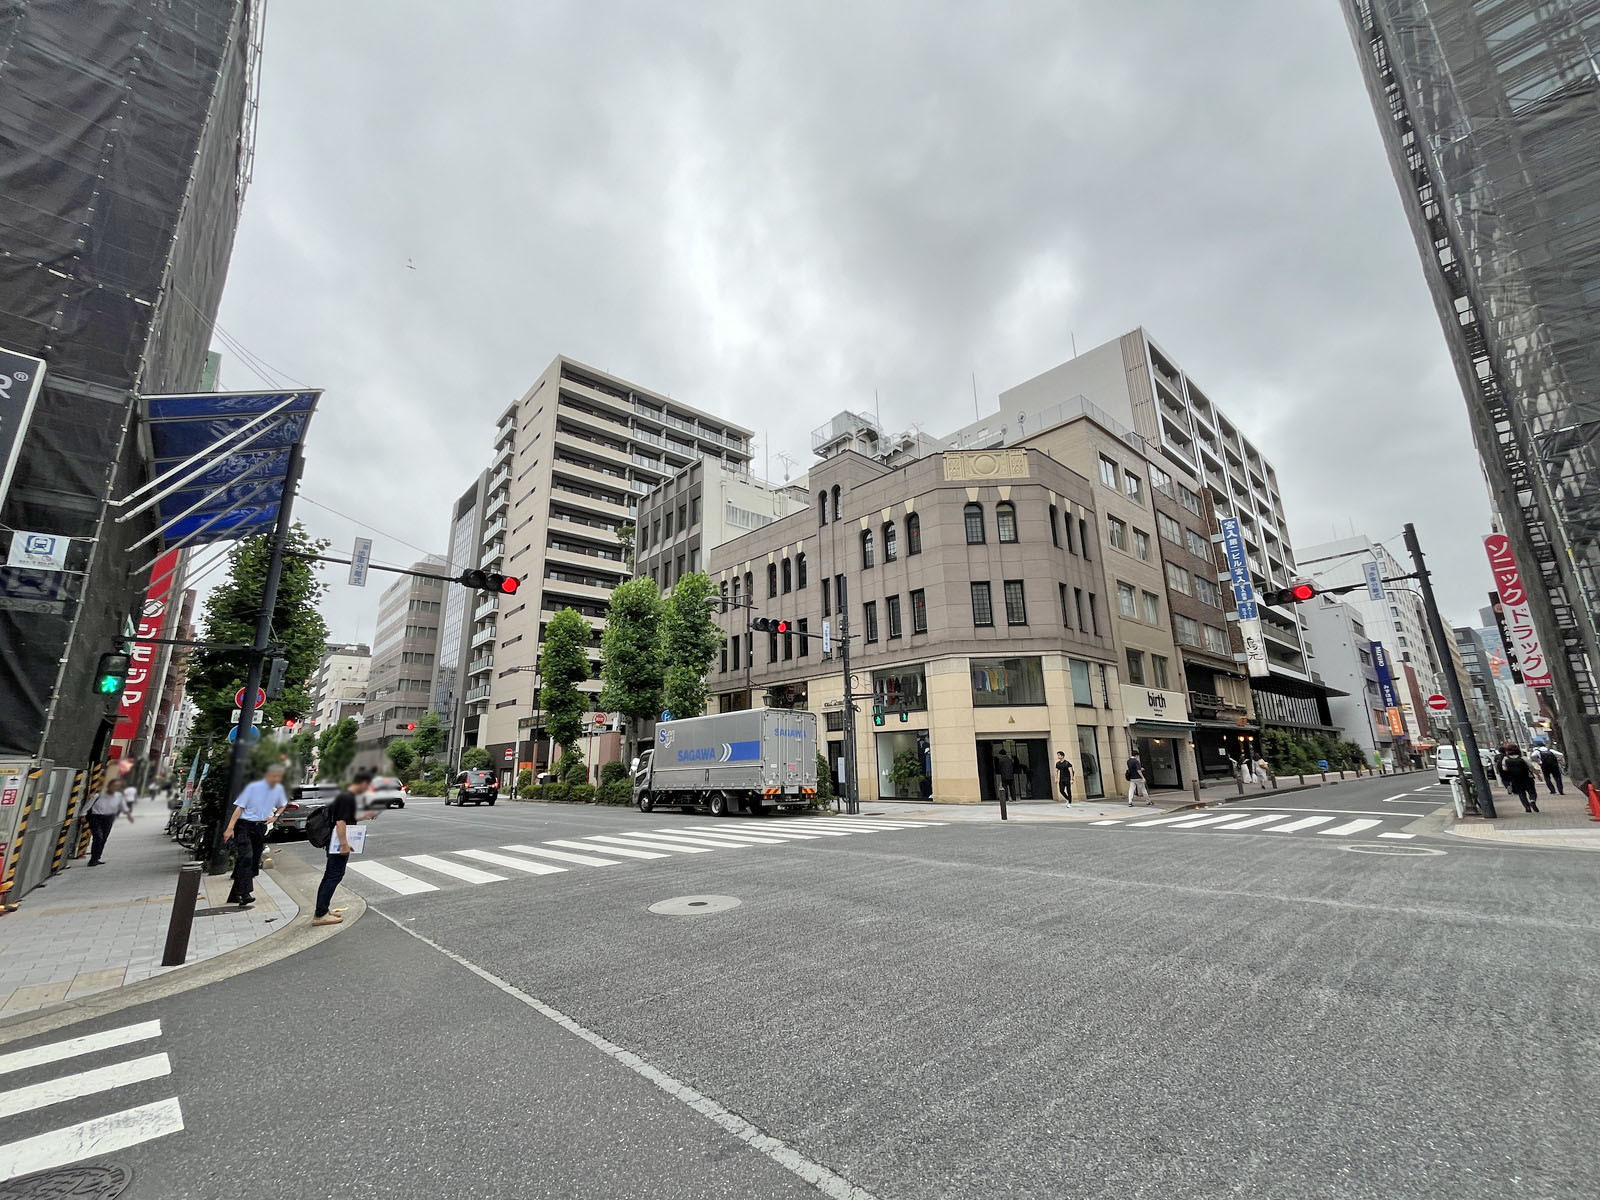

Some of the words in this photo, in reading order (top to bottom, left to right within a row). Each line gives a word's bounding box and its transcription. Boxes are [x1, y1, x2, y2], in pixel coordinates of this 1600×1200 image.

[1488, 541, 1543, 671] ソニックドラッグ
[122, 623, 157, 707] シモジマ
[1147, 691, 1167, 708] birth
[774, 728, 806, 738] SAGAWA
[678, 748, 716, 762] SAGAWA
